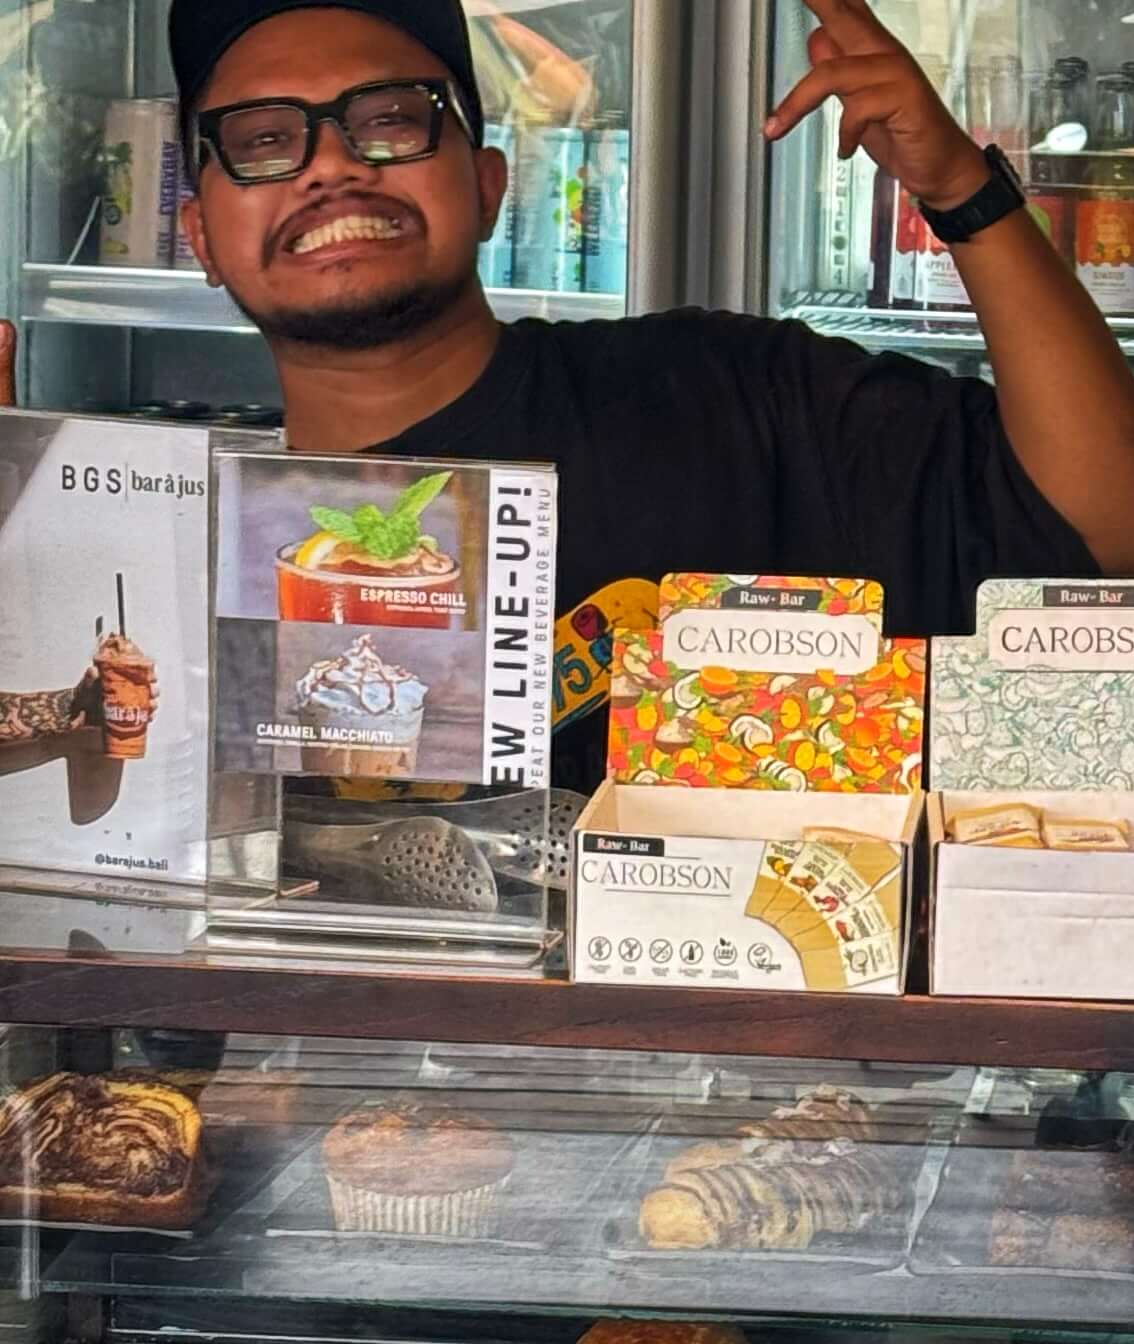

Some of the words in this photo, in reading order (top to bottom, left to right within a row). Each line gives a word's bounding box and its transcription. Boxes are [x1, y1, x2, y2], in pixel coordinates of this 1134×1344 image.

[536, 487, 551, 537] MENU
[360, 587, 427, 605] ESPRESSO
[429, 591, 467, 607] CHILL
[492, 486, 532, 699] LINE-UP!
[534, 548, 550, 642] BEVERAGE
[1098, 589, 1124, 605] Bar
[677, 625, 863, 659] CAROBSON
[534, 653, 548, 690] NEW
[256, 723, 318, 740] CARAMEL
[320, 726, 394, 744] MACCHIATO
[531, 700, 546, 736] OUR
[629, 839, 650, 852] Bar
[581, 859, 733, 890] CAROBSON
